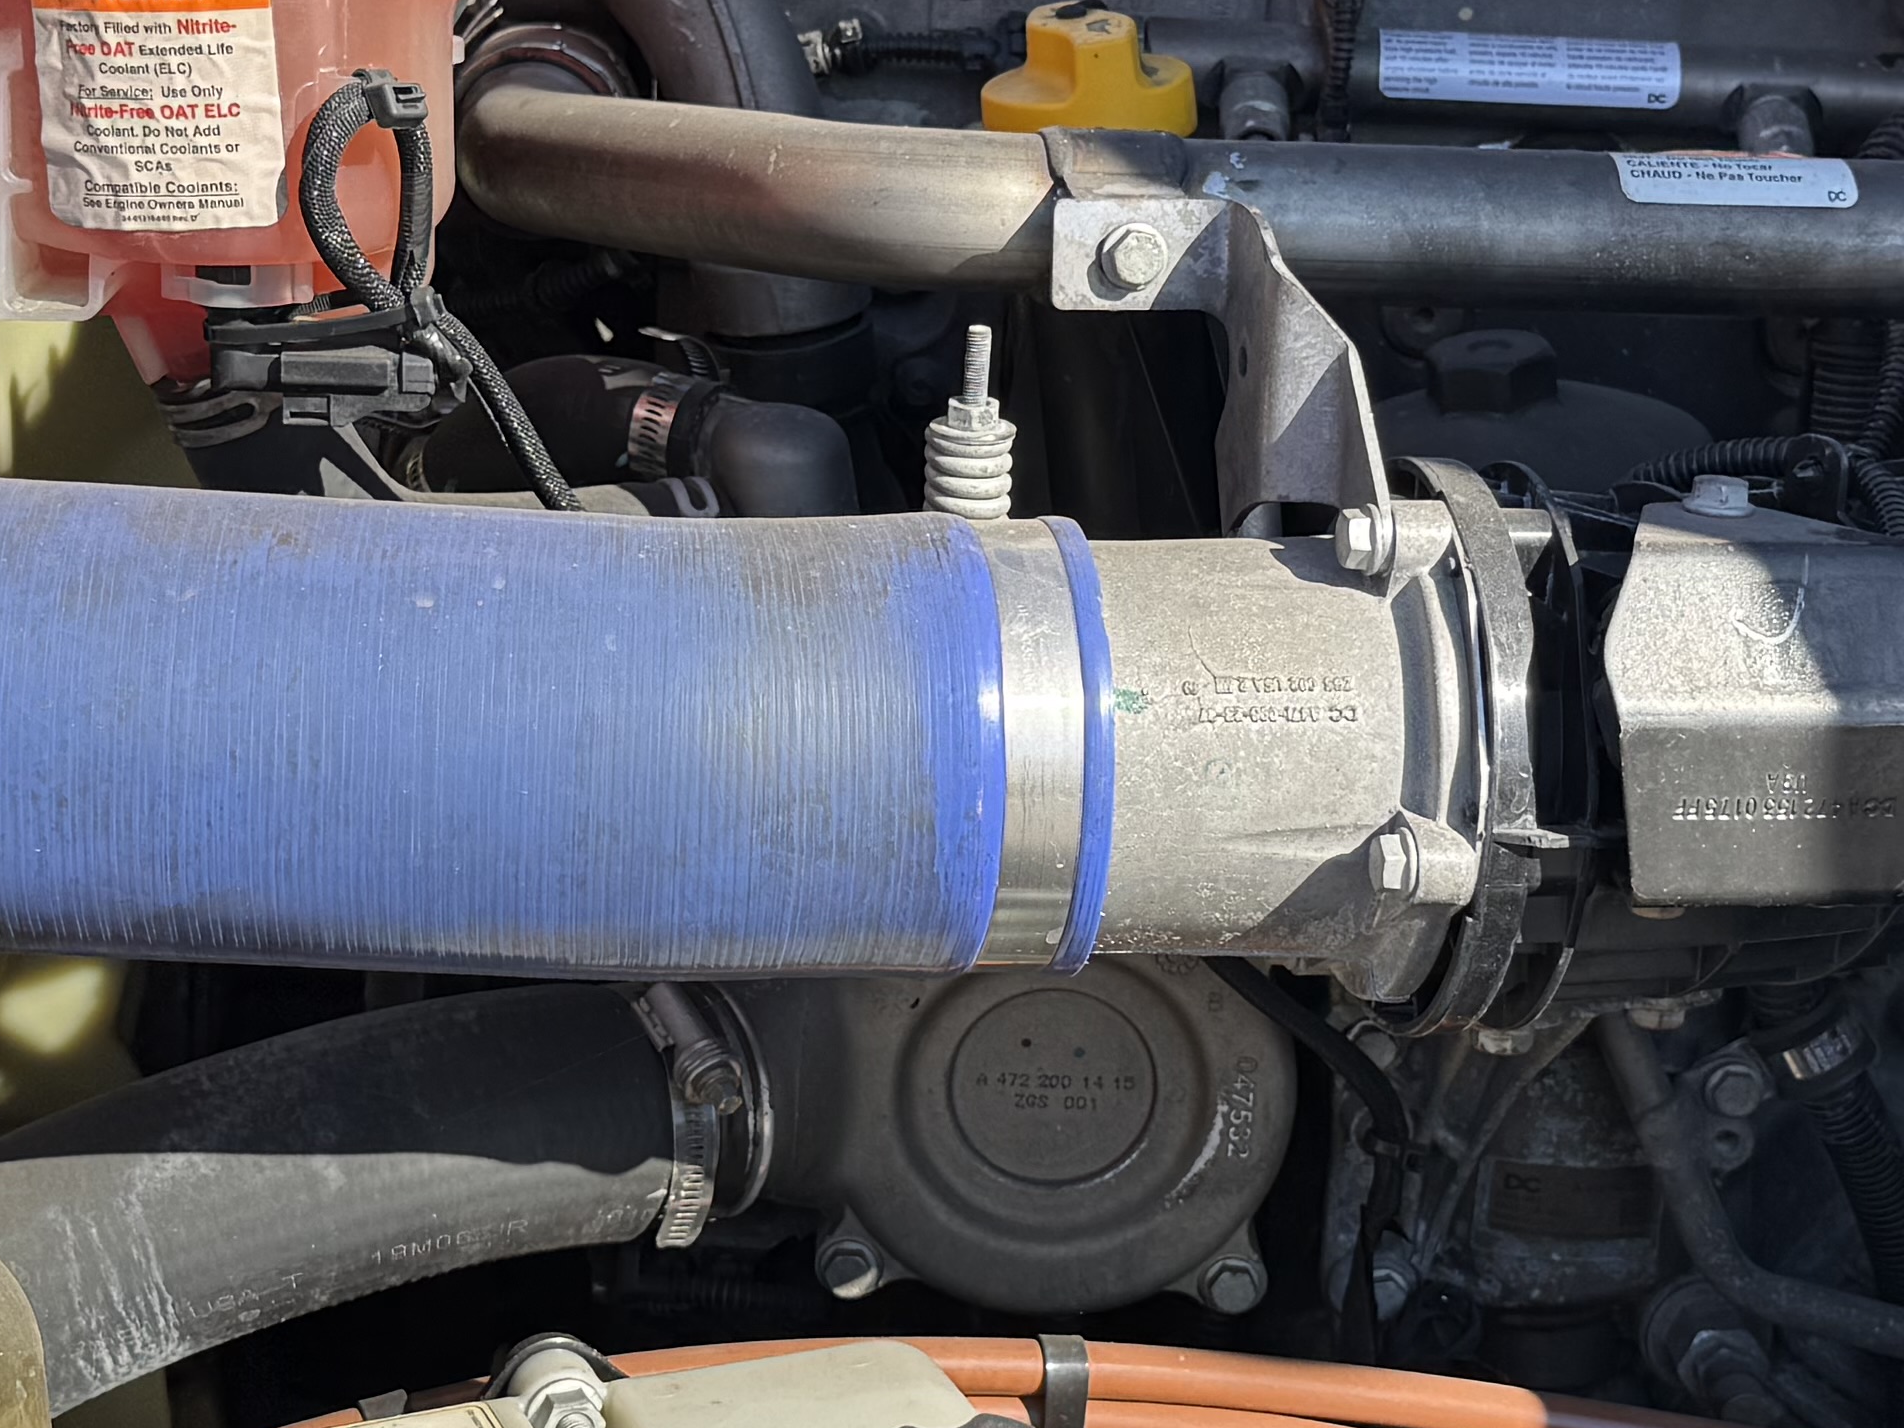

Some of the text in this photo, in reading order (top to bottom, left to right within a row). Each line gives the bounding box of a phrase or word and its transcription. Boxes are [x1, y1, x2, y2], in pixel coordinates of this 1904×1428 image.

[104, 21, 139, 34] Filled
[144, 22, 172, 35] with
[177, 19, 237, 35] Nitrite-
[66, 39, 234, 57] Free OAT Extended Life
[99, 62, 192, 78] Coolant (ELC)
[79, 85, 223, 99] For Service: Use Only
[1648, 94, 1667, 104] DC
[70, 101, 241, 119] Nitrite-Free OAT ELC
[87, 124, 221, 138] Coolant. Do Not Add
[74, 140, 240, 155] Conventional Coolants or
[134, 160, 173, 172] SCAs
[1712, 162, 1733, 170] No
[1631, 169, 1682, 180] CHAUD
[1718, 172, 1744, 181] Pas
[1748, 173, 1803, 183] Toucher
[84, 179, 238, 195] Compatible Coolants:
[1828, 190, 1846, 202] DC
[83, 197, 102, 208] See
[105, 198, 145, 211] Engine
[199, 197, 244, 209] Manual
[1766, 773, 1807, 794] USA
[996, 1073, 1031, 1088] 472
[1038, 1074, 1072, 1089] 200
[1082, 1075, 1104, 1090] 14
[1112, 1075, 1137, 1090] 15
[1014, 1093, 1099, 1110] ZGS 001
